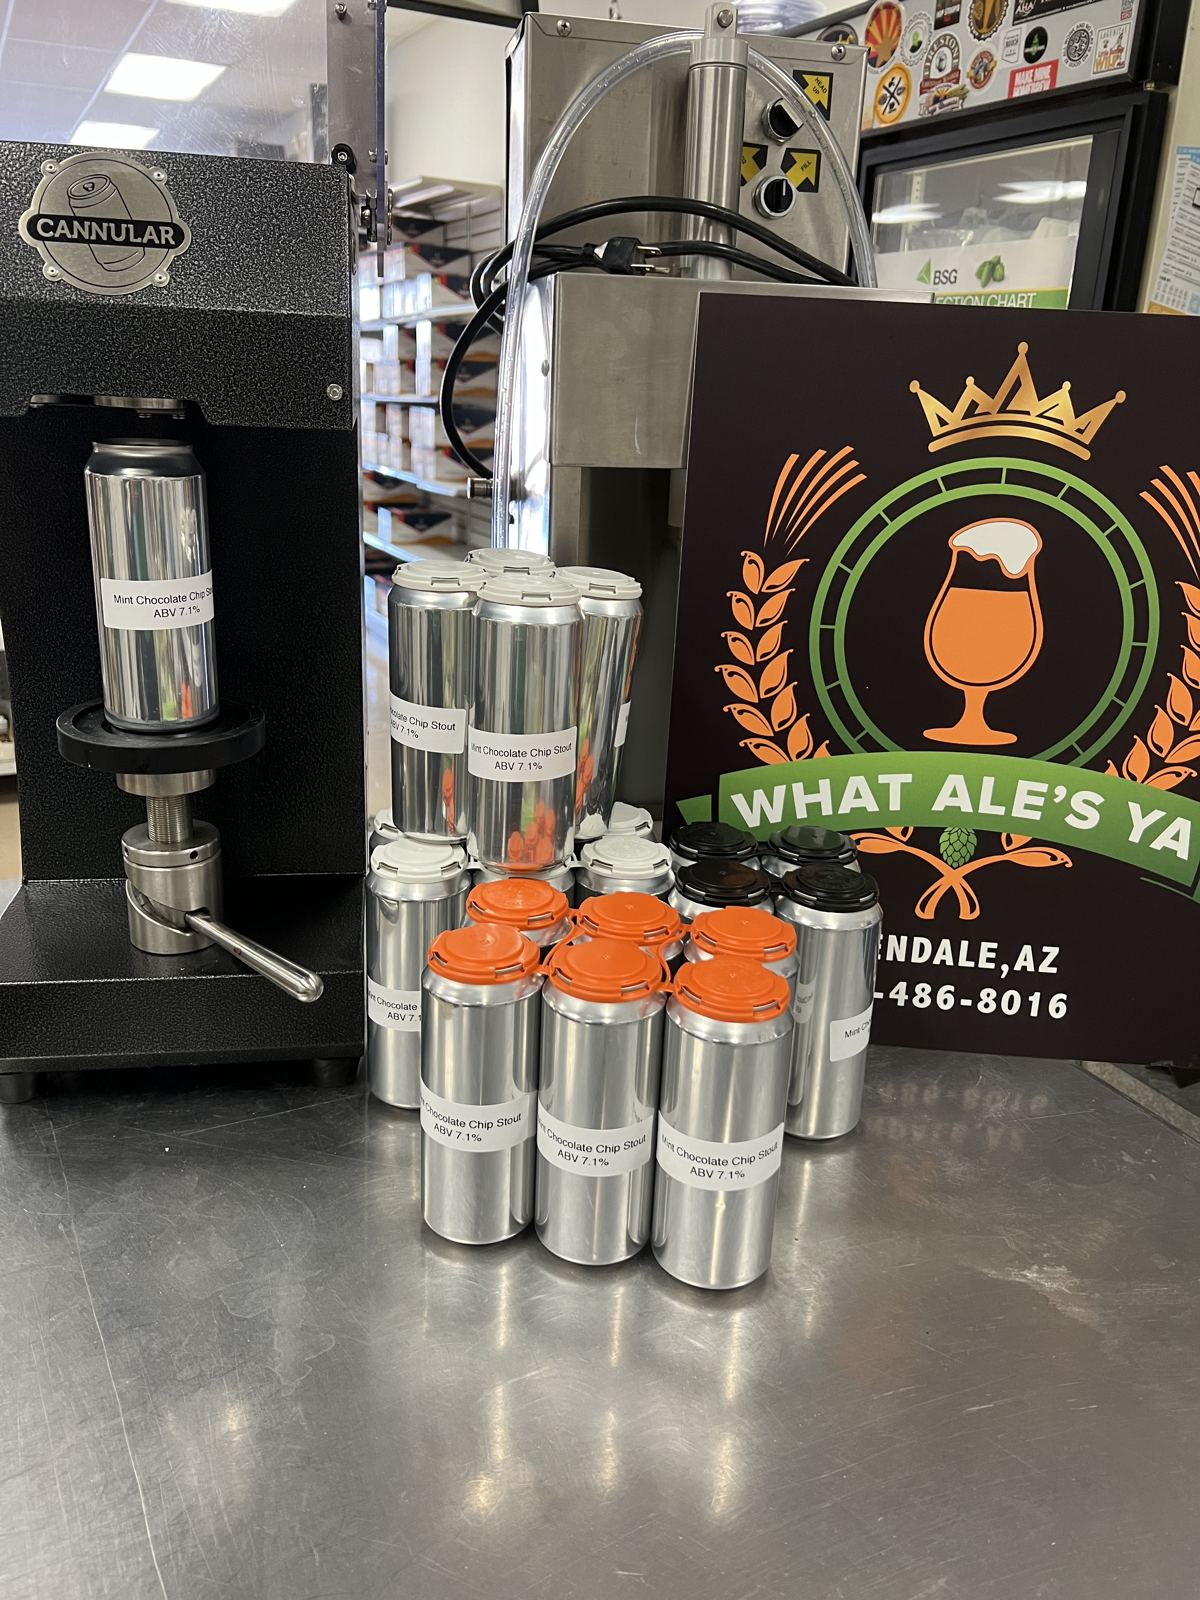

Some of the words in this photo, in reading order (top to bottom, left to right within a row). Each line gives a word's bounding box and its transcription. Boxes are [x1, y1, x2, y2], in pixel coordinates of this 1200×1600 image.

[812, 86, 820, 95] UP
[815, 77, 828, 94] HEAD
[800, 160, 812, 171] FILL
[36, 217, 176, 246] CANNULAR
[933, 269, 958, 286] BSG
[113, 594, 134, 604] Mint
[136, 594, 187, 605] Chocolate
[189, 590, 205, 601] Chip
[153, 608, 176, 618] ABV
[179, 605, 201, 616] 7.1%
[400, 725, 419, 739] 7.1%
[409, 716, 429, 730] Chip
[431, 720, 456, 732] Stout
[483, 745, 528, 758] Chocolate
[530, 748, 552, 758] Chip
[553, 742, 573, 755] Stout
[494, 761, 515, 771] ABV
[518, 762, 543, 771] 7.1%
[730, 773, 913, 828] WHAT
[931, 773, 1105, 830] ALE'S
[1127, 800, 1192, 861] YA
[878, 933, 1060, 979] NDALE,AZ
[377, 996, 418, 1011] Chocolate
[387, 1011, 406, 1021] ABV
[844, 1026, 861, 1039] Mint
[425, 1102, 466, 1127] Chocolate
[469, 1120, 494, 1131] Chip
[496, 1112, 522, 1127] Stout
[433, 1123, 453, 1137] ABV
[456, 1130, 482, 1142] 7.1%
[547, 1128, 593, 1153] Chocolate
[595, 1144, 621, 1154] Chip
[623, 1134, 646, 1150] Stout
[557, 1149, 579, 1162] ABV
[581, 1156, 609, 1166] 7.1%
[676, 1146, 729, 1166] Chocolate
[731, 1155, 756, 1166] Chip
[758, 1141, 778, 1160] Stout
[690, 1166, 714, 1179] ABV
[717, 1170, 745, 1180] 7.1%
